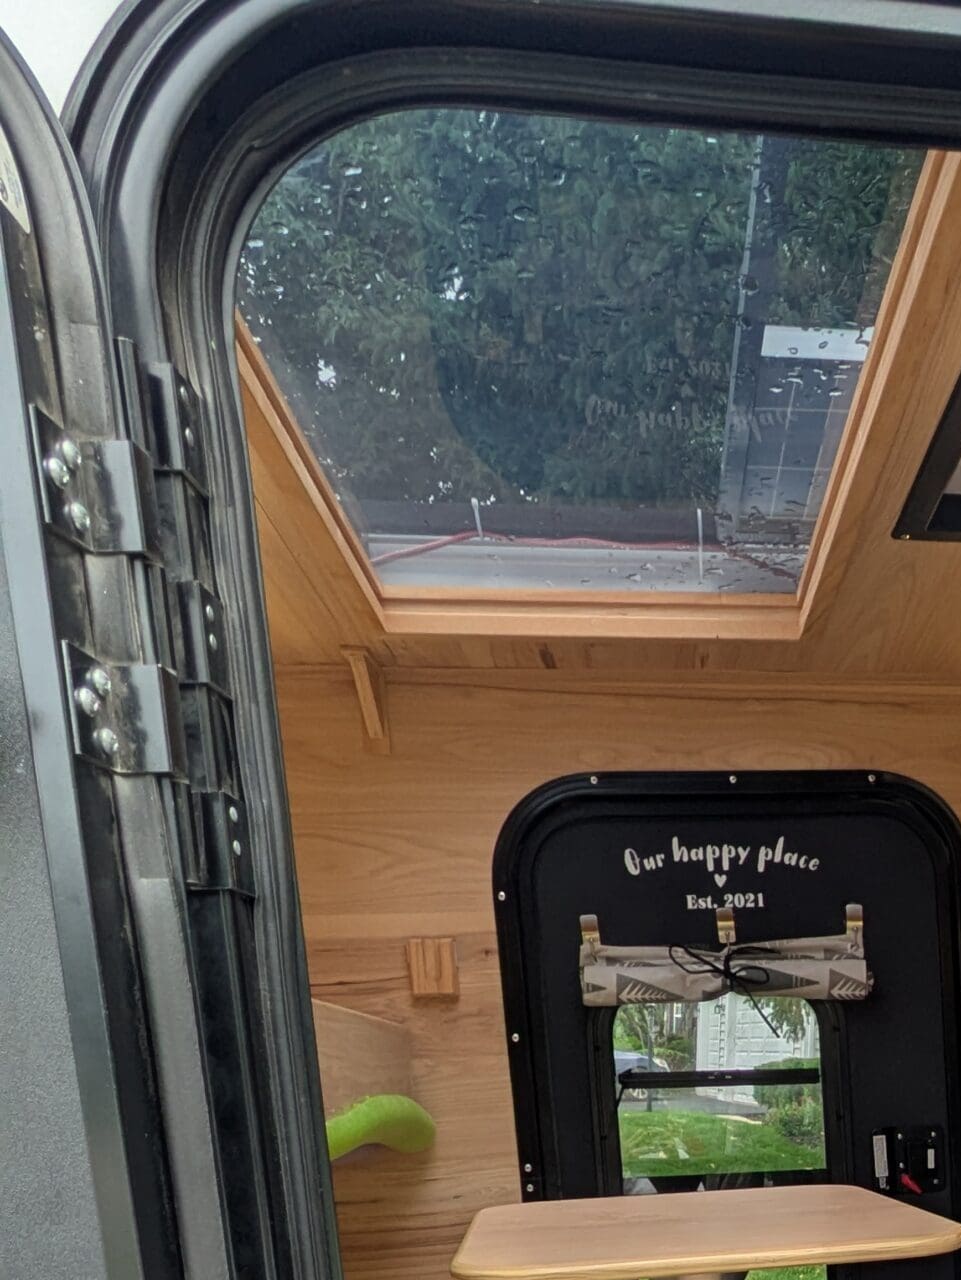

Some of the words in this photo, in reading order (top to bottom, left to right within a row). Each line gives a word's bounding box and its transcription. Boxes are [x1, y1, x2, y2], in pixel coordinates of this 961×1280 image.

[624, 848, 665, 876] Our
[672, 836, 751, 872] happy
[757, 836, 820, 873] place
[686, 894, 718, 910] Est.
[724, 893, 765, 908] 2021
